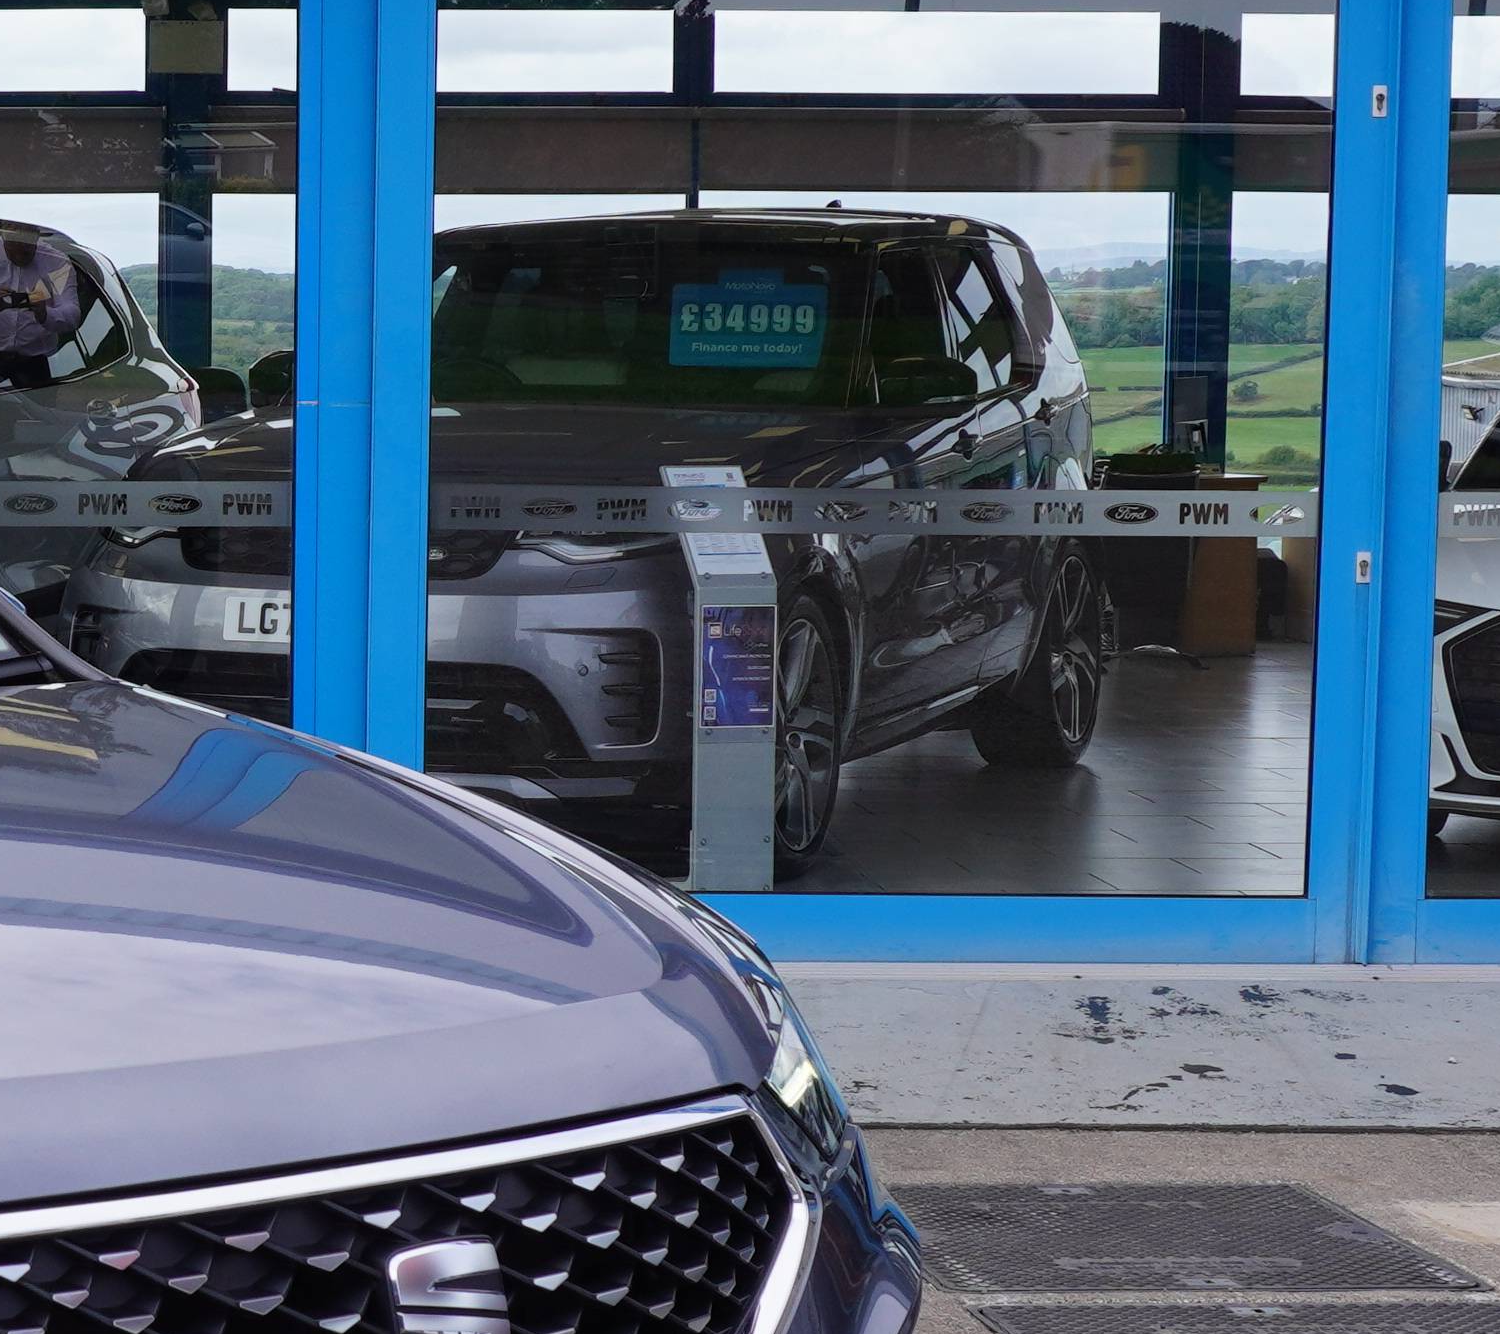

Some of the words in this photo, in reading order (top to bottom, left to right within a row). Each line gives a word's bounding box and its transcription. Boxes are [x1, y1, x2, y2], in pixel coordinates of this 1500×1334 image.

[680, 303, 815, 334] £34999
[691, 342, 738, 353] Finance
[741, 344, 761, 353] me
[763, 343, 803, 355] today!
[78, 493, 128, 516] PWM
[222, 493, 272, 516] PWM
[449, 496, 502, 519] PWM
[596, 499, 649, 521] PWM
[743, 499, 793, 522] PWM
[1179, 503, 1229, 525] PWM
